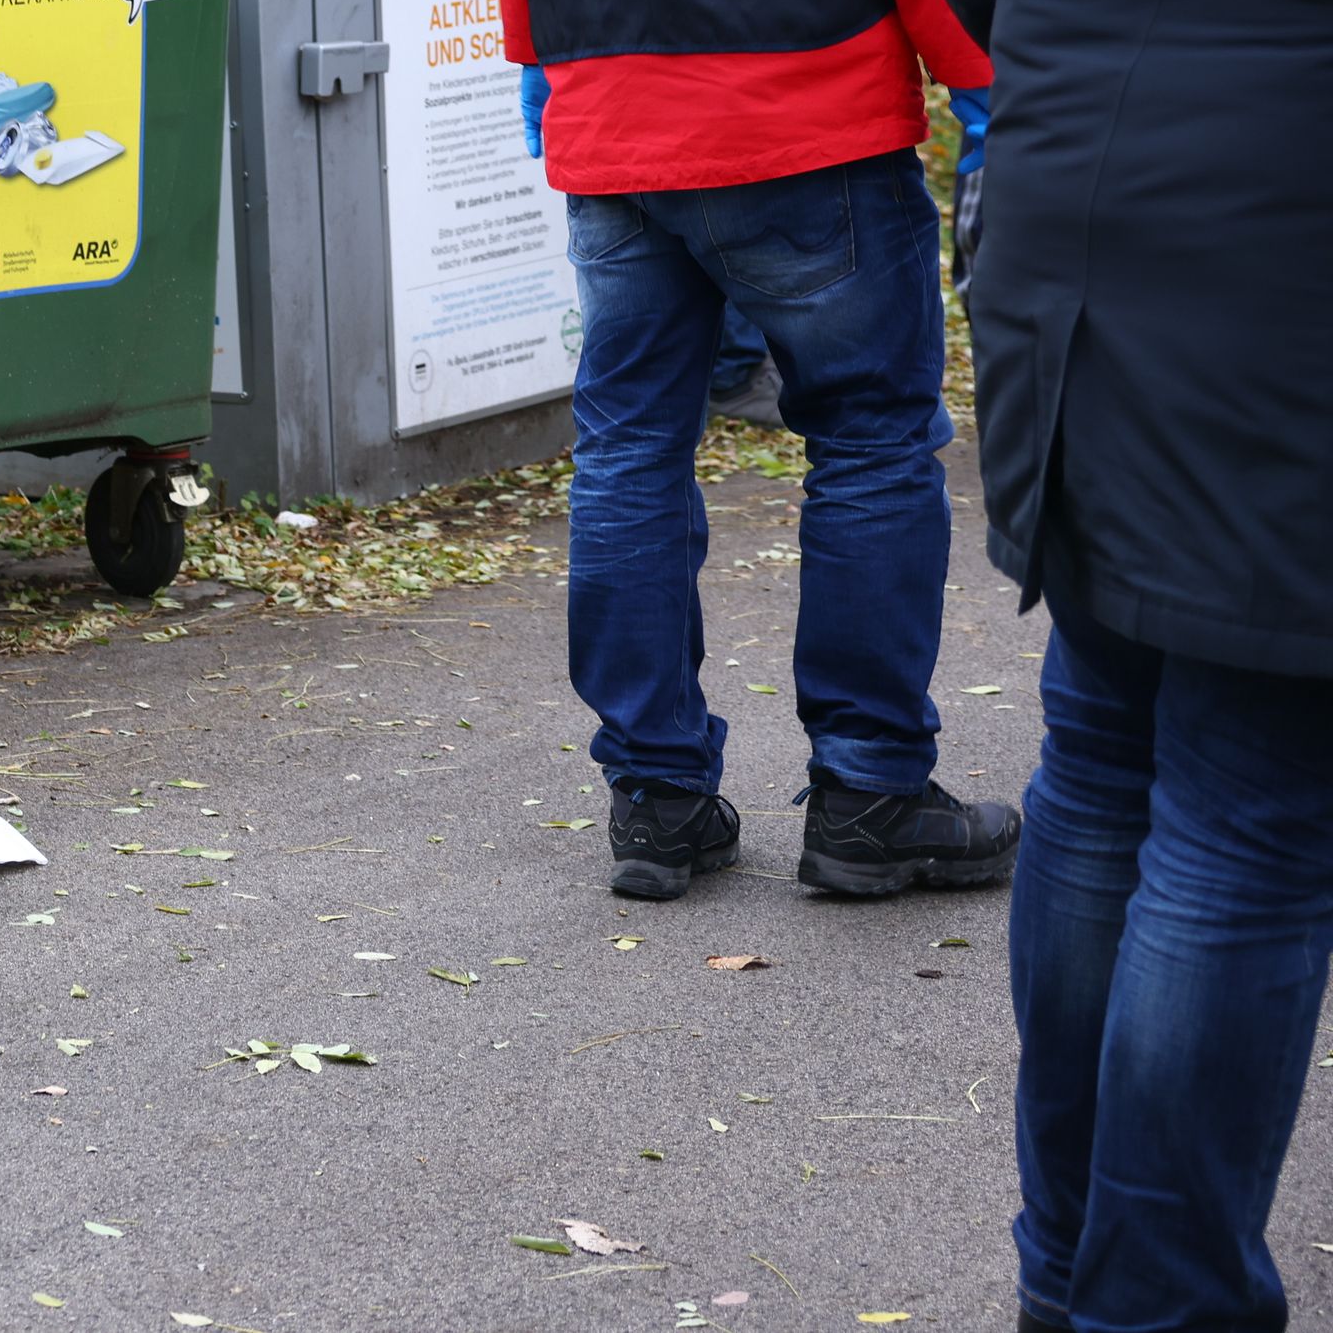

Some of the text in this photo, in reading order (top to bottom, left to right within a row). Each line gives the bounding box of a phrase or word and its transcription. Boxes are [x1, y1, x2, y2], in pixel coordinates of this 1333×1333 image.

[426, 31, 505, 68] UND SCH
[72, 240, 111, 261] ARA
